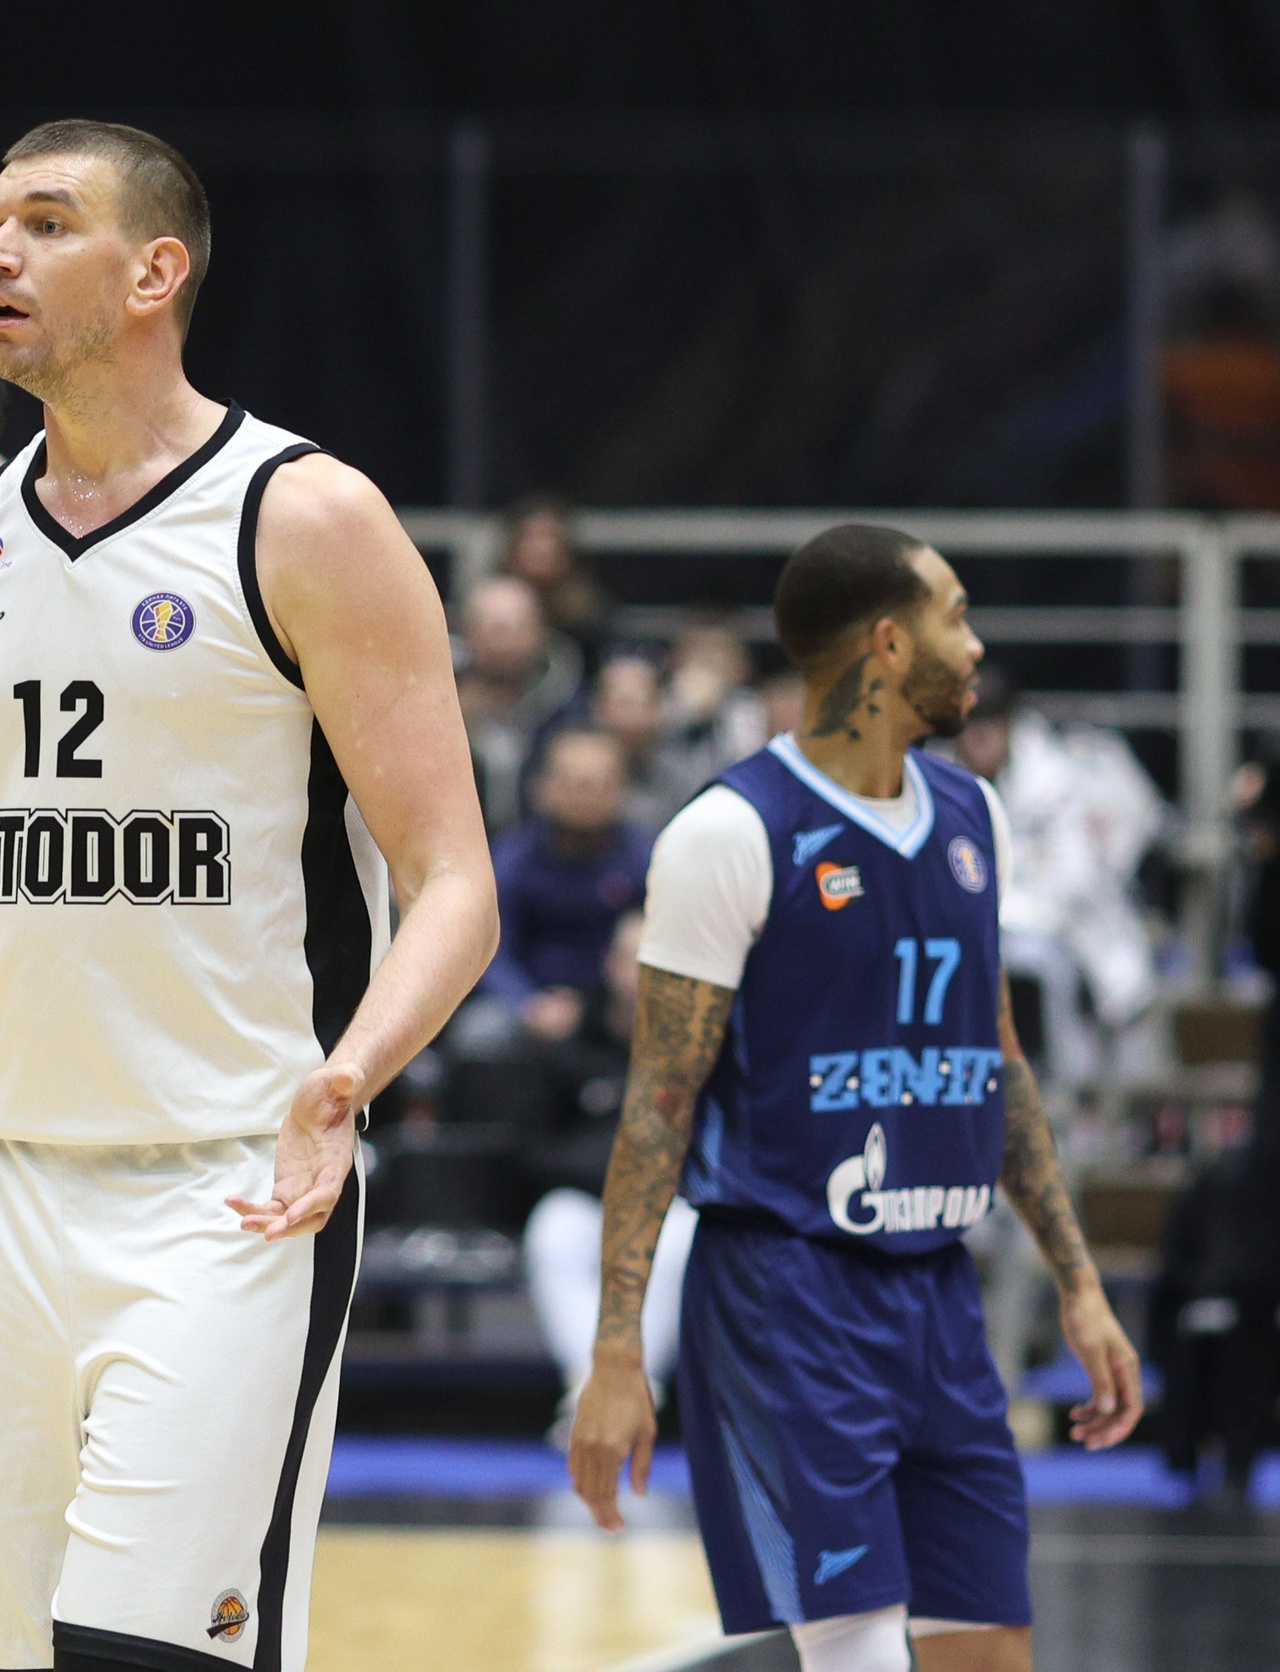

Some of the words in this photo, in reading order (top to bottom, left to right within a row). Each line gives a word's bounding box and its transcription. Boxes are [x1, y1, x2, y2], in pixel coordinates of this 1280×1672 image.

[13, 680, 105, 778] 12
[894, 938, 961, 1024] 17
[810, 1047, 1003, 1112] ZENIT
